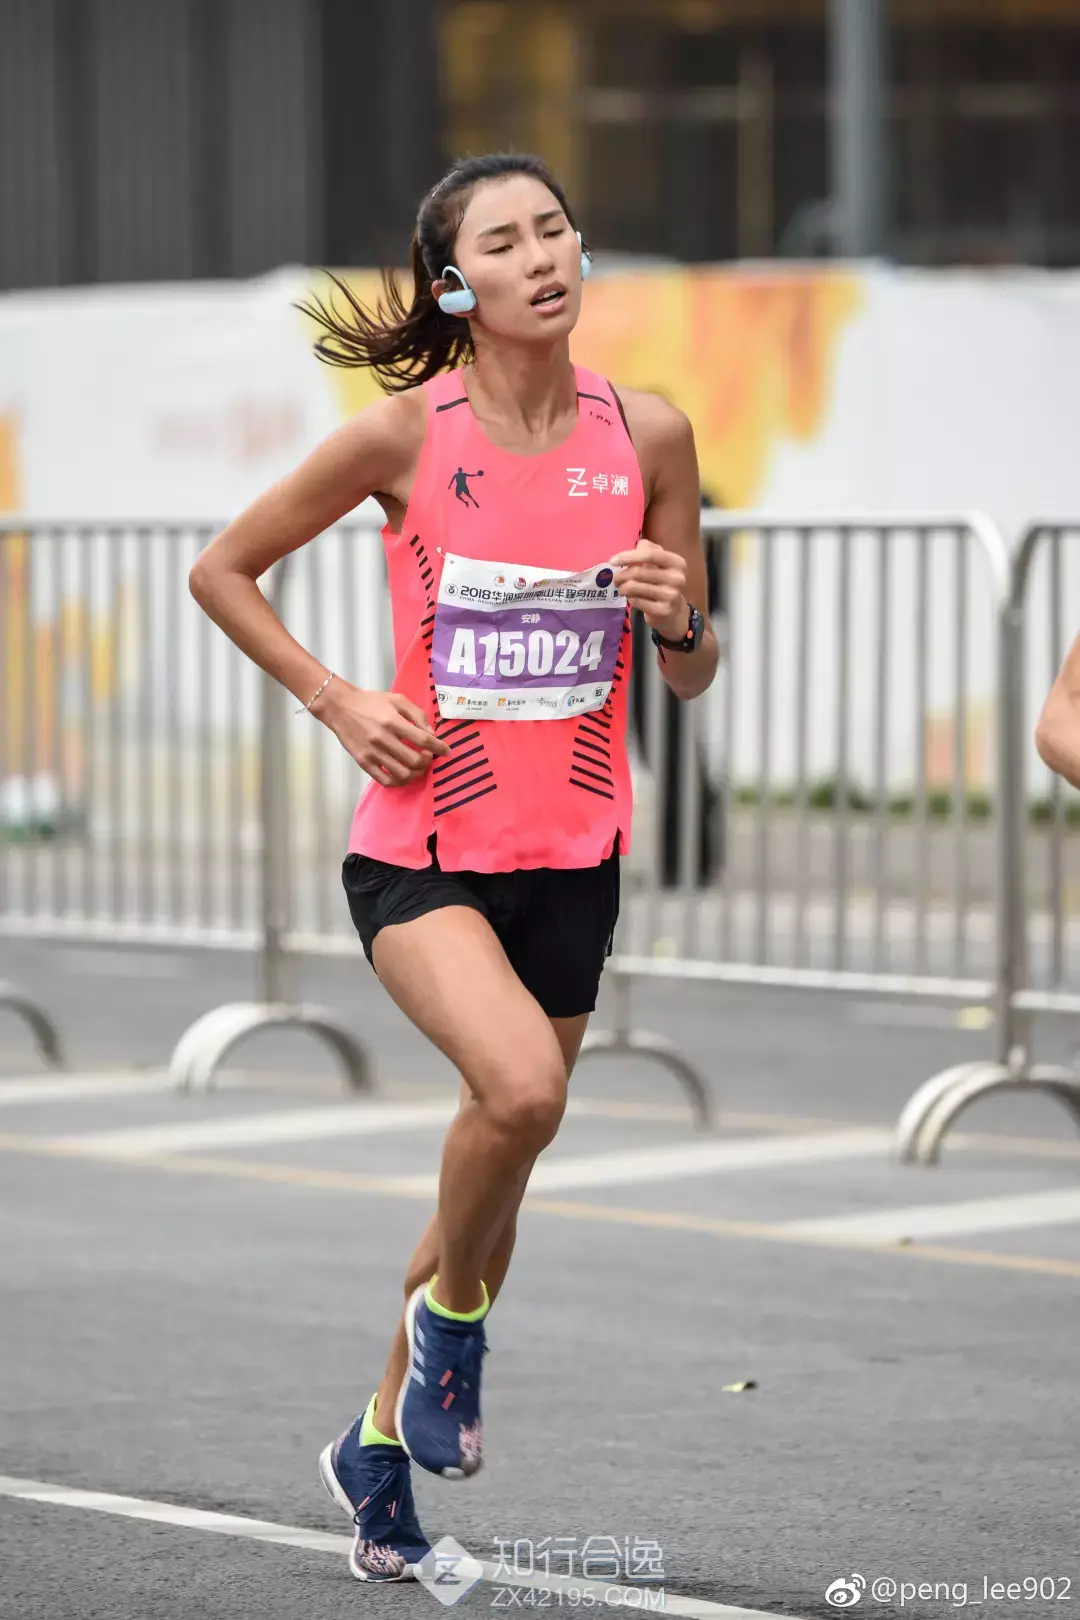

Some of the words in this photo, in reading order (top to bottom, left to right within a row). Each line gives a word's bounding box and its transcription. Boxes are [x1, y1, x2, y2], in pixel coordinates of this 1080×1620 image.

[592, 473, 628, 496] 卓澜
[521, 613, 541, 624] 安静
[446, 627, 605, 677] A15024
